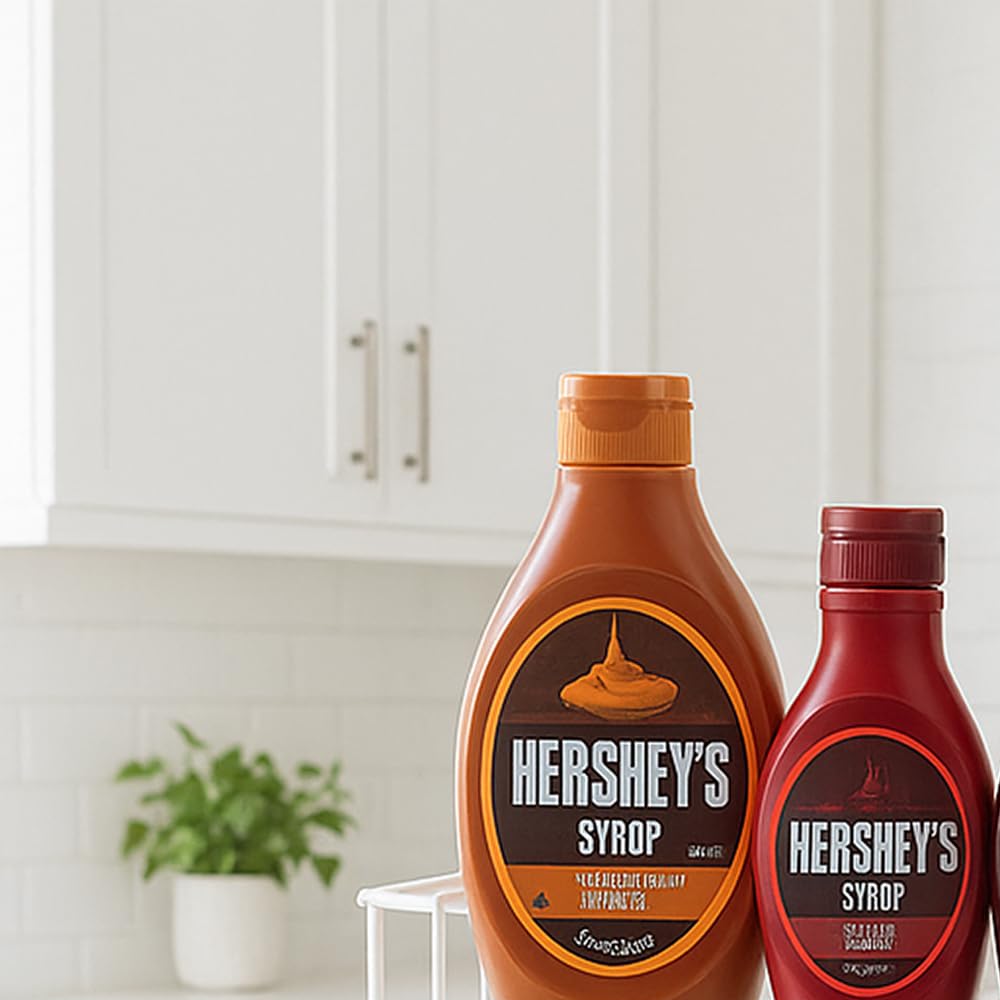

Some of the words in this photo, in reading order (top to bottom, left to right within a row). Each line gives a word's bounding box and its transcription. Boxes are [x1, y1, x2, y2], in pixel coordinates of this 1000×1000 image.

[512, 739, 730, 808] HERSHEY'S
[578, 819, 662, 856] SYROP
[789, 821, 959, 874] HERSHEY'S
[842, 882, 905, 911] SYROP
